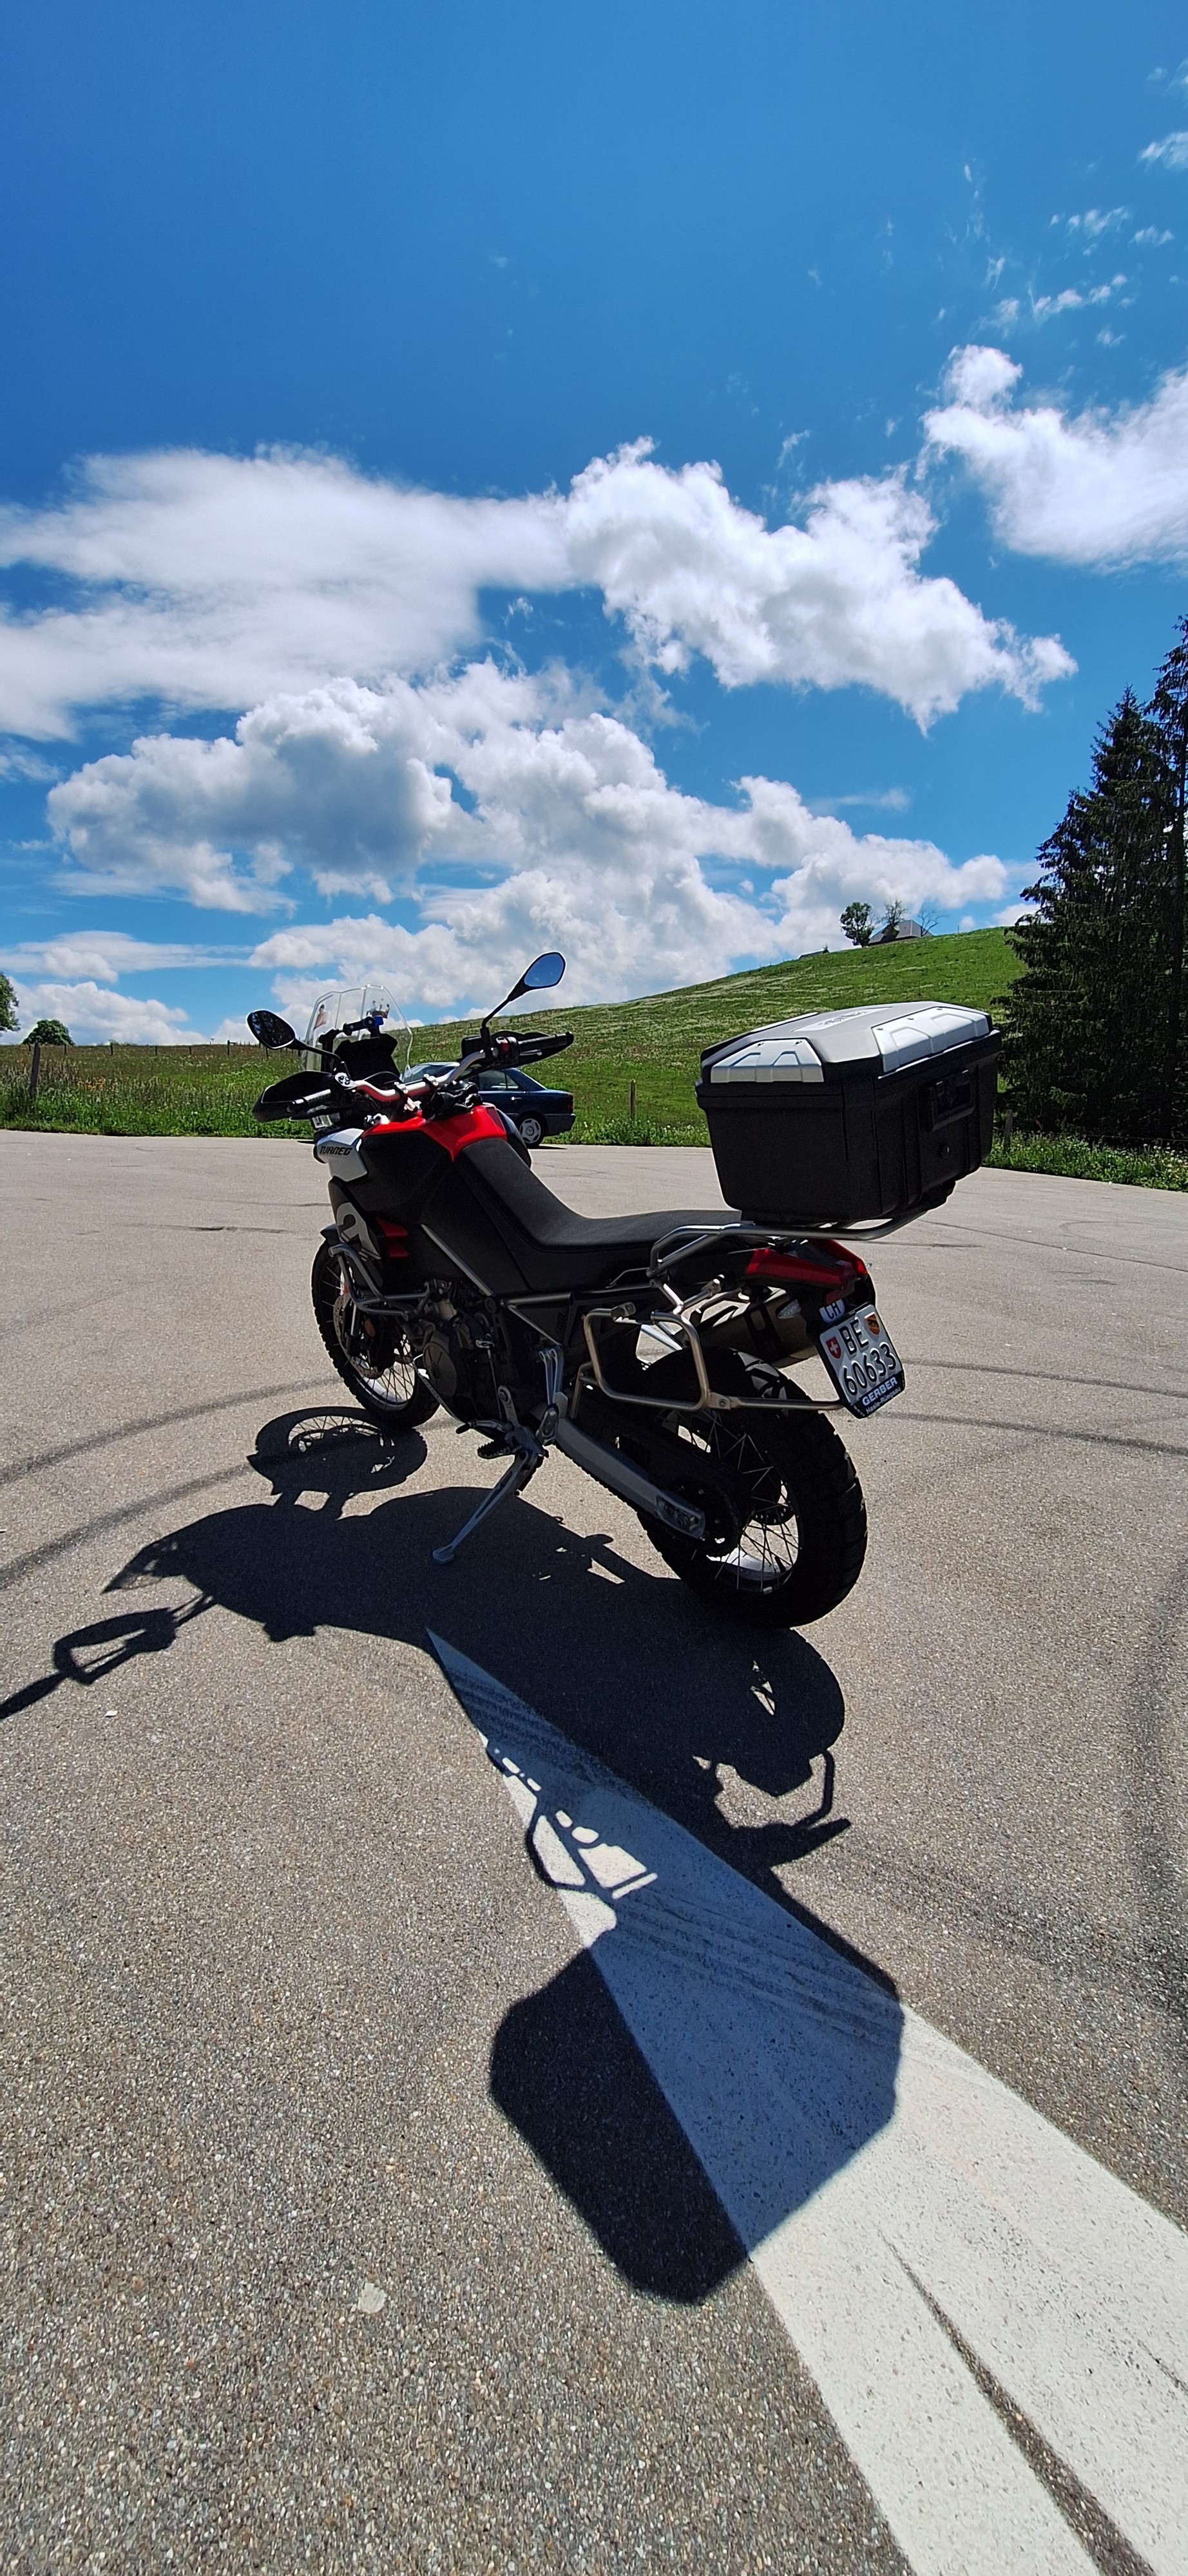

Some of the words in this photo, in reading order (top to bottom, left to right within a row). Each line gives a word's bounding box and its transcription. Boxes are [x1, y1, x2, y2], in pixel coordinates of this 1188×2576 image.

[839, 1318, 869, 1356] BE
[843, 1342, 897, 1396] 60633
[862, 1376, 898, 1406] GERBER
